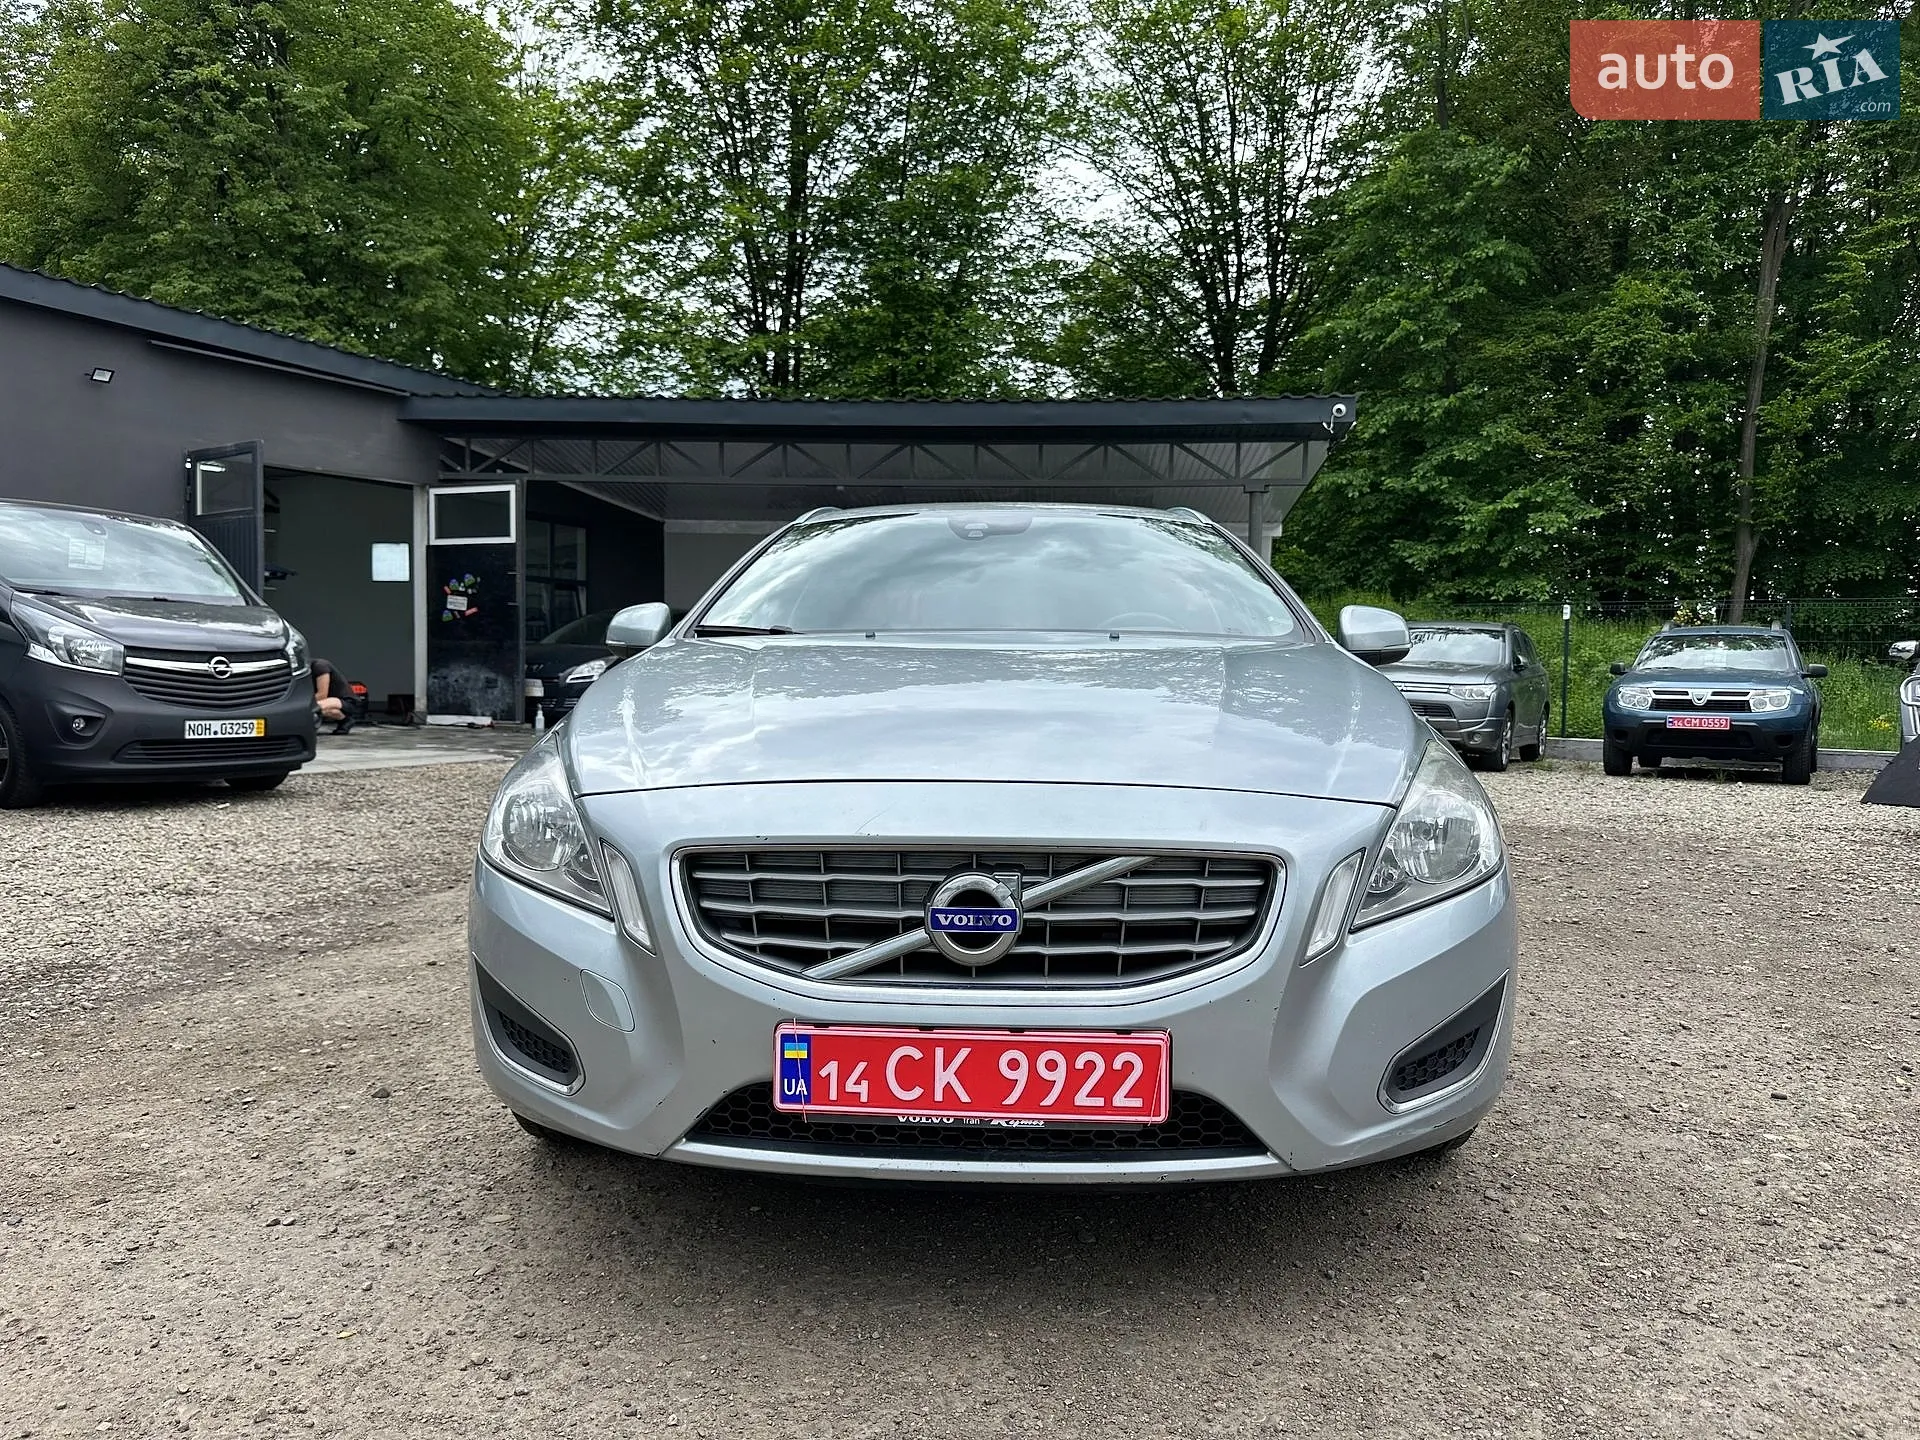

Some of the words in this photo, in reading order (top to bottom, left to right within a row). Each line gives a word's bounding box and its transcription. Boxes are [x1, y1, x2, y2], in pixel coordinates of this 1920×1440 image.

[1684, 718, 1700, 727] CM
[1701, 719, 1727, 728] 0559
[935, 913, 1012, 926] VOLVO
[819, 1060, 869, 1103] 14
[885, 1045, 972, 1103] CK
[998, 1049, 1144, 1107] 9922
[783, 1078, 808, 1096] UA
